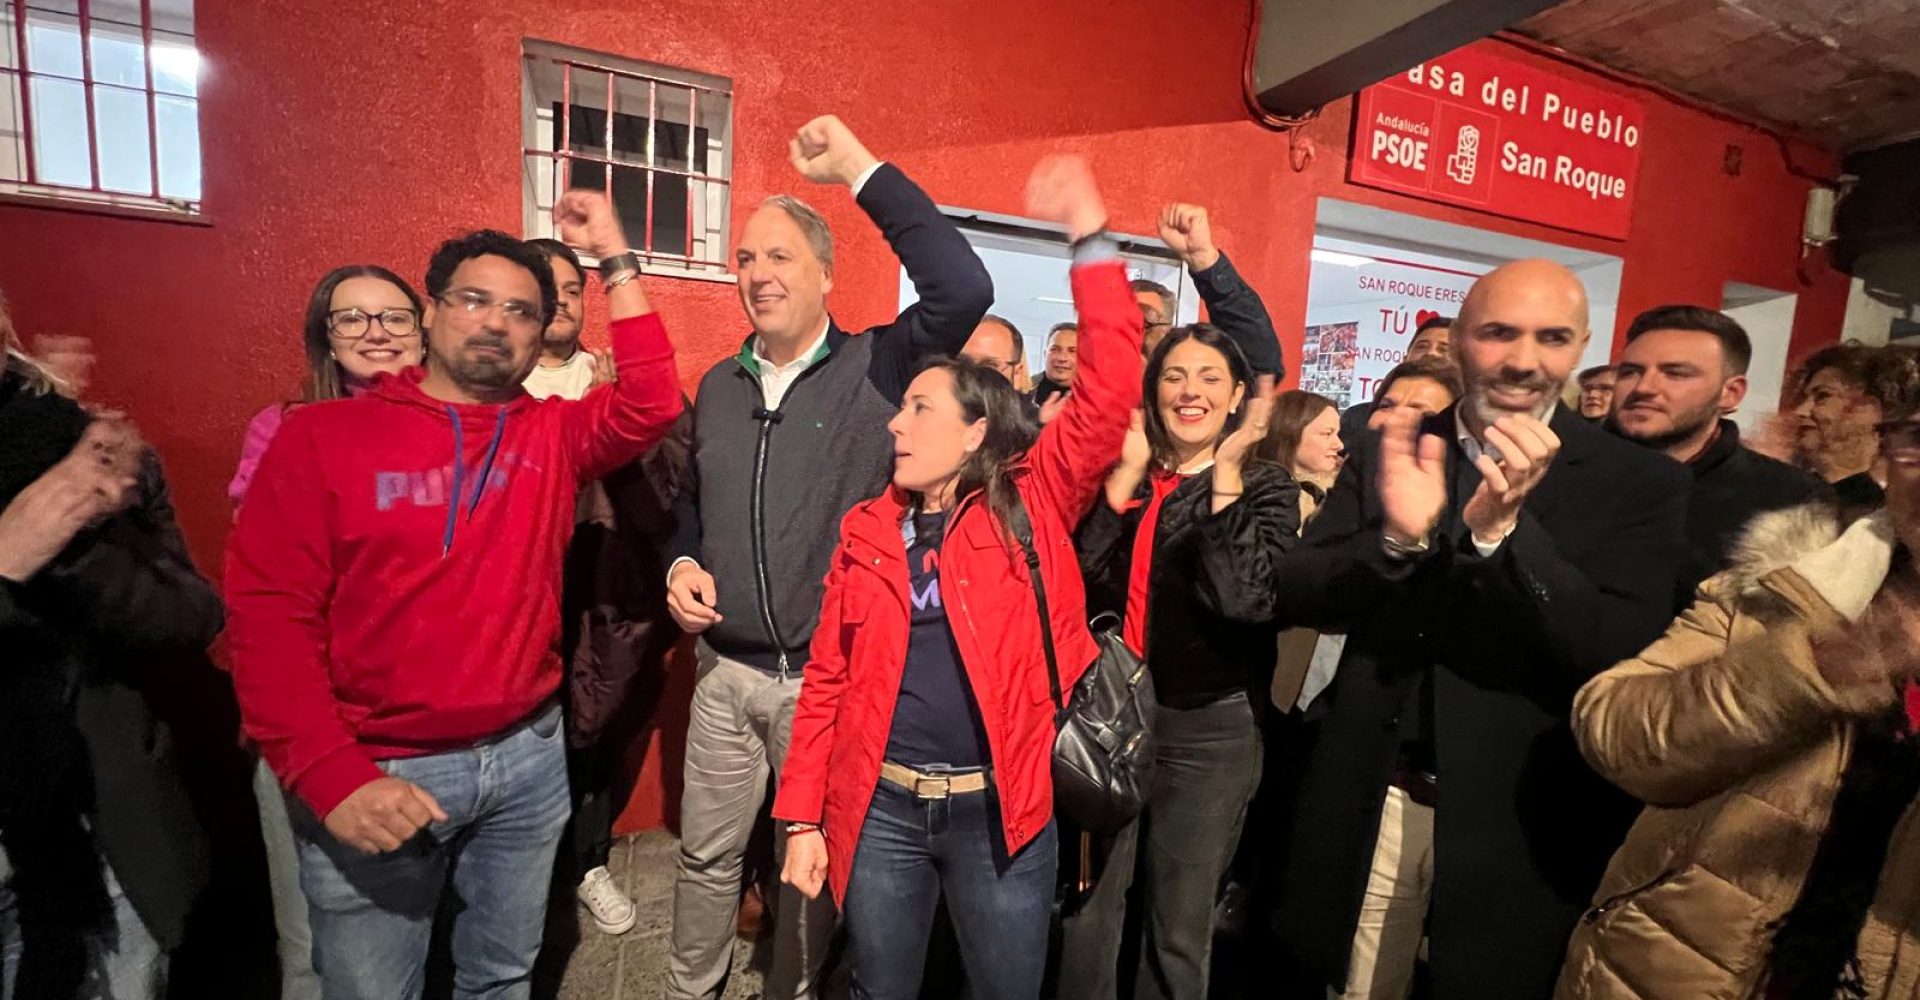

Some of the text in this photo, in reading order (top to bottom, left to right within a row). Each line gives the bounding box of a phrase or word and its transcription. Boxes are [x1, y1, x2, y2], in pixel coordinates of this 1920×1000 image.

[1407, 63, 1638, 147] asa del Pueblo
[1376, 112, 1429, 136] Andalucía
[1371, 130, 1429, 171] PSOE
[1500, 141, 1626, 200] San Roque
[1359, 276, 1385, 291] SAN
[1389, 281, 1432, 298] ROQUE
[1380, 305, 1408, 334] TÚ
[1374, 348, 1405, 363] ROQ
